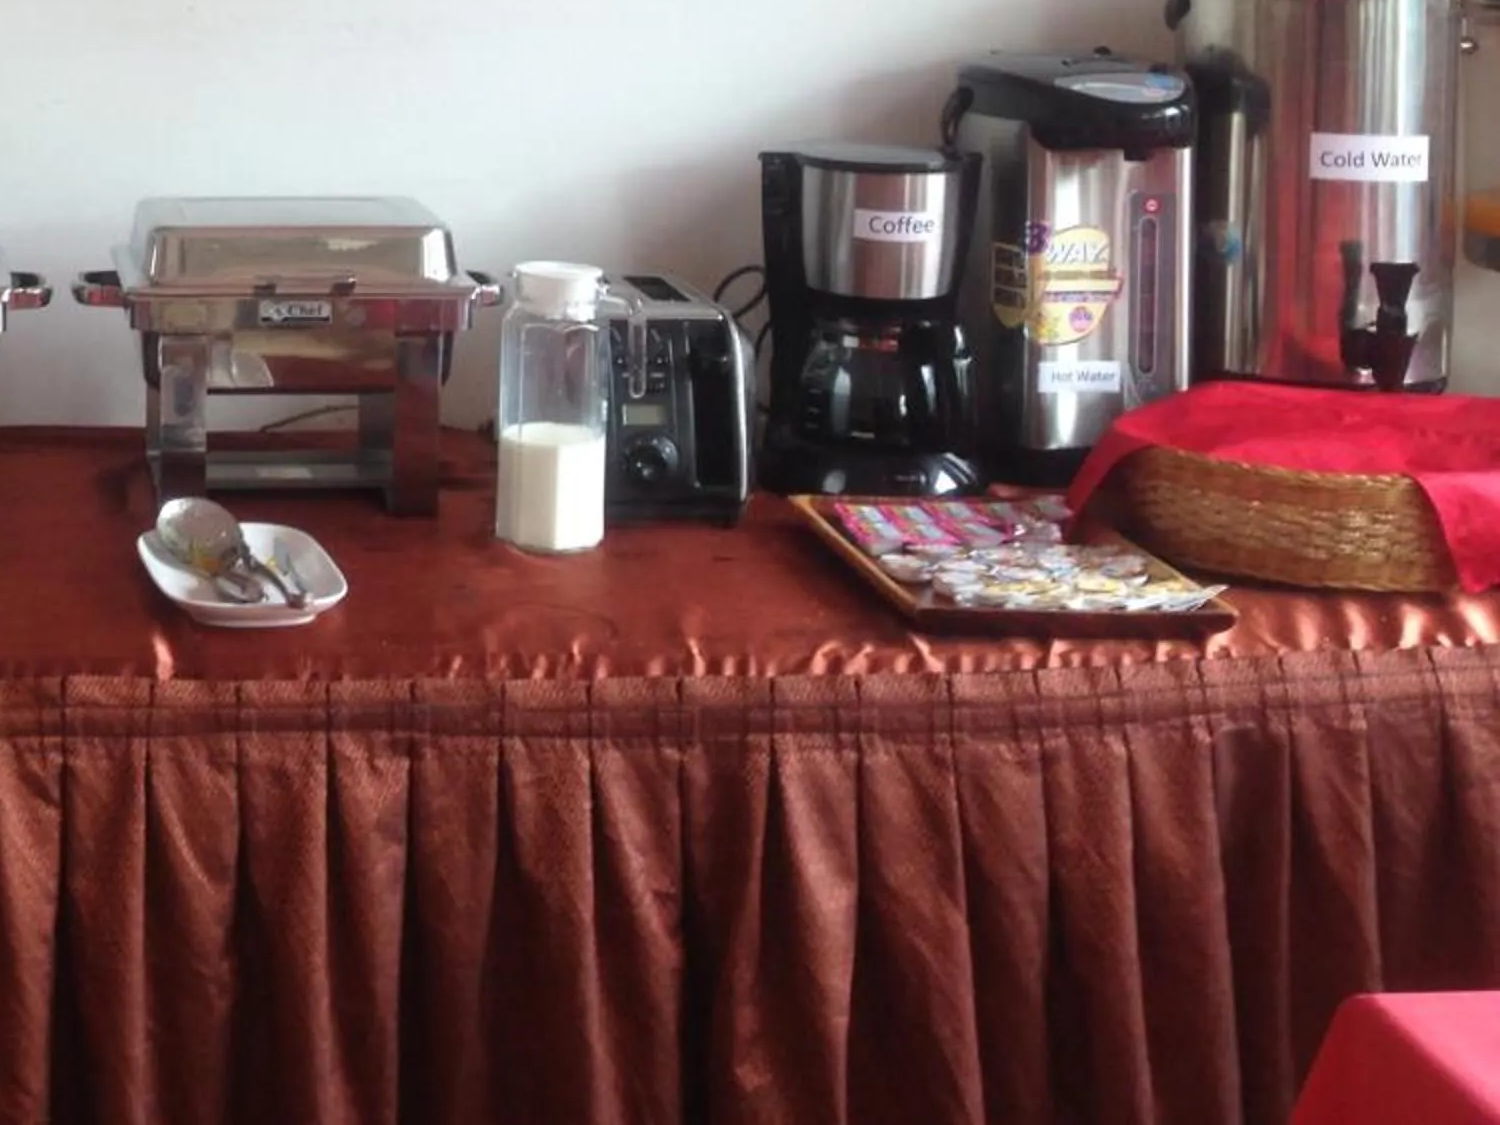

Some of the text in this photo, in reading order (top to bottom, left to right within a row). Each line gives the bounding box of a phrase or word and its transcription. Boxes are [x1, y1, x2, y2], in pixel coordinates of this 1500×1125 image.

[1321, 151, 1422, 168] Cold Water
[868, 215, 935, 234] Coffee
[1051, 370, 1115, 382] Hot Water
